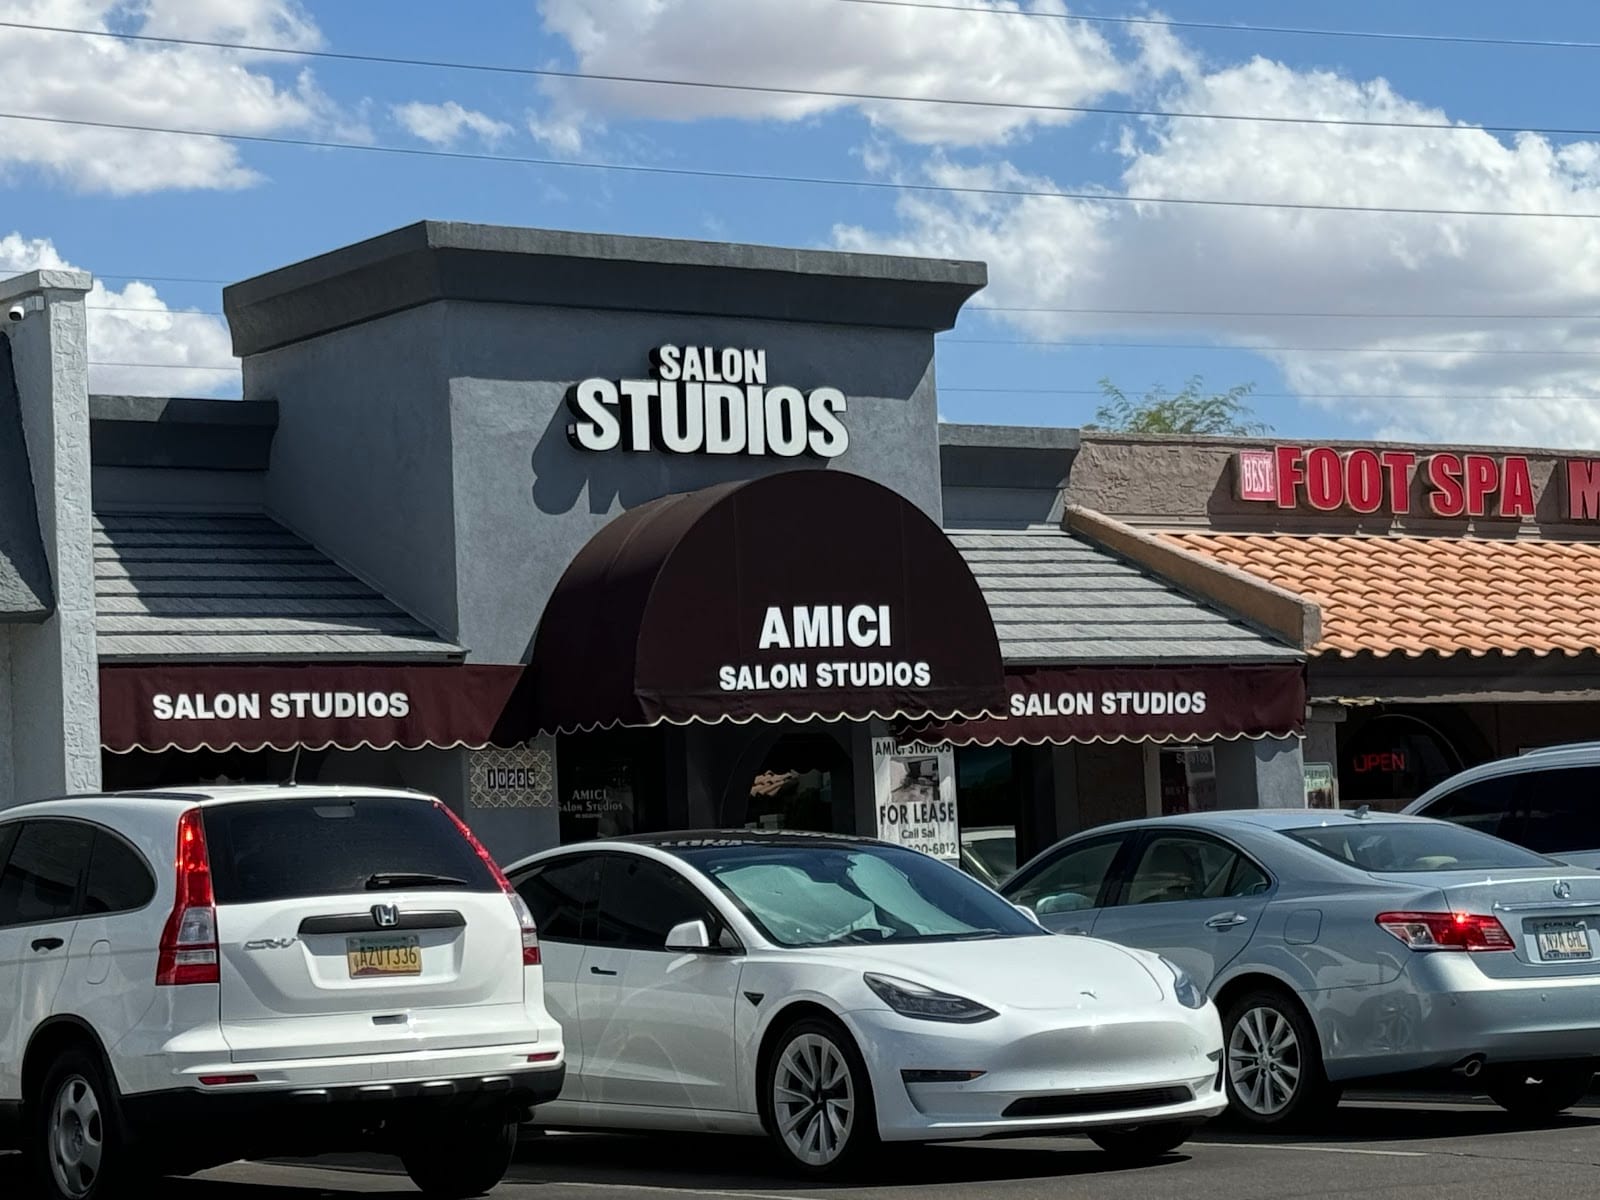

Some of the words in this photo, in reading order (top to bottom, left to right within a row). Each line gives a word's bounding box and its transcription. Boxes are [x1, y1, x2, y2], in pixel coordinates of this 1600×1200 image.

[659, 344, 767, 384] SALON
[576, 378, 849, 457] STUDIOS
[1244, 459, 1271, 492] BEST
[1275, 446, 1416, 514] FOOT
[1428, 453, 1536, 518] SPA
[758, 604, 892, 649] AMICI
[719, 663, 808, 691] SALON
[816, 661, 931, 688] STUDIOS
[153, 693, 260, 720] SALON
[270, 691, 410, 719] STUDIOS
[1010, 692, 1094, 717] SALON
[1101, 691, 1206, 715] STUDIOS
[1353, 752, 1405, 772] OPEN
[489, 771, 535, 786] 10235
[572, 789, 607, 800] AMICI
[880, 804, 908, 825] FOR
[913, 802, 954, 823] LEASE
[901, 829, 919, 839] Call
[921, 828, 935, 838] Sal
